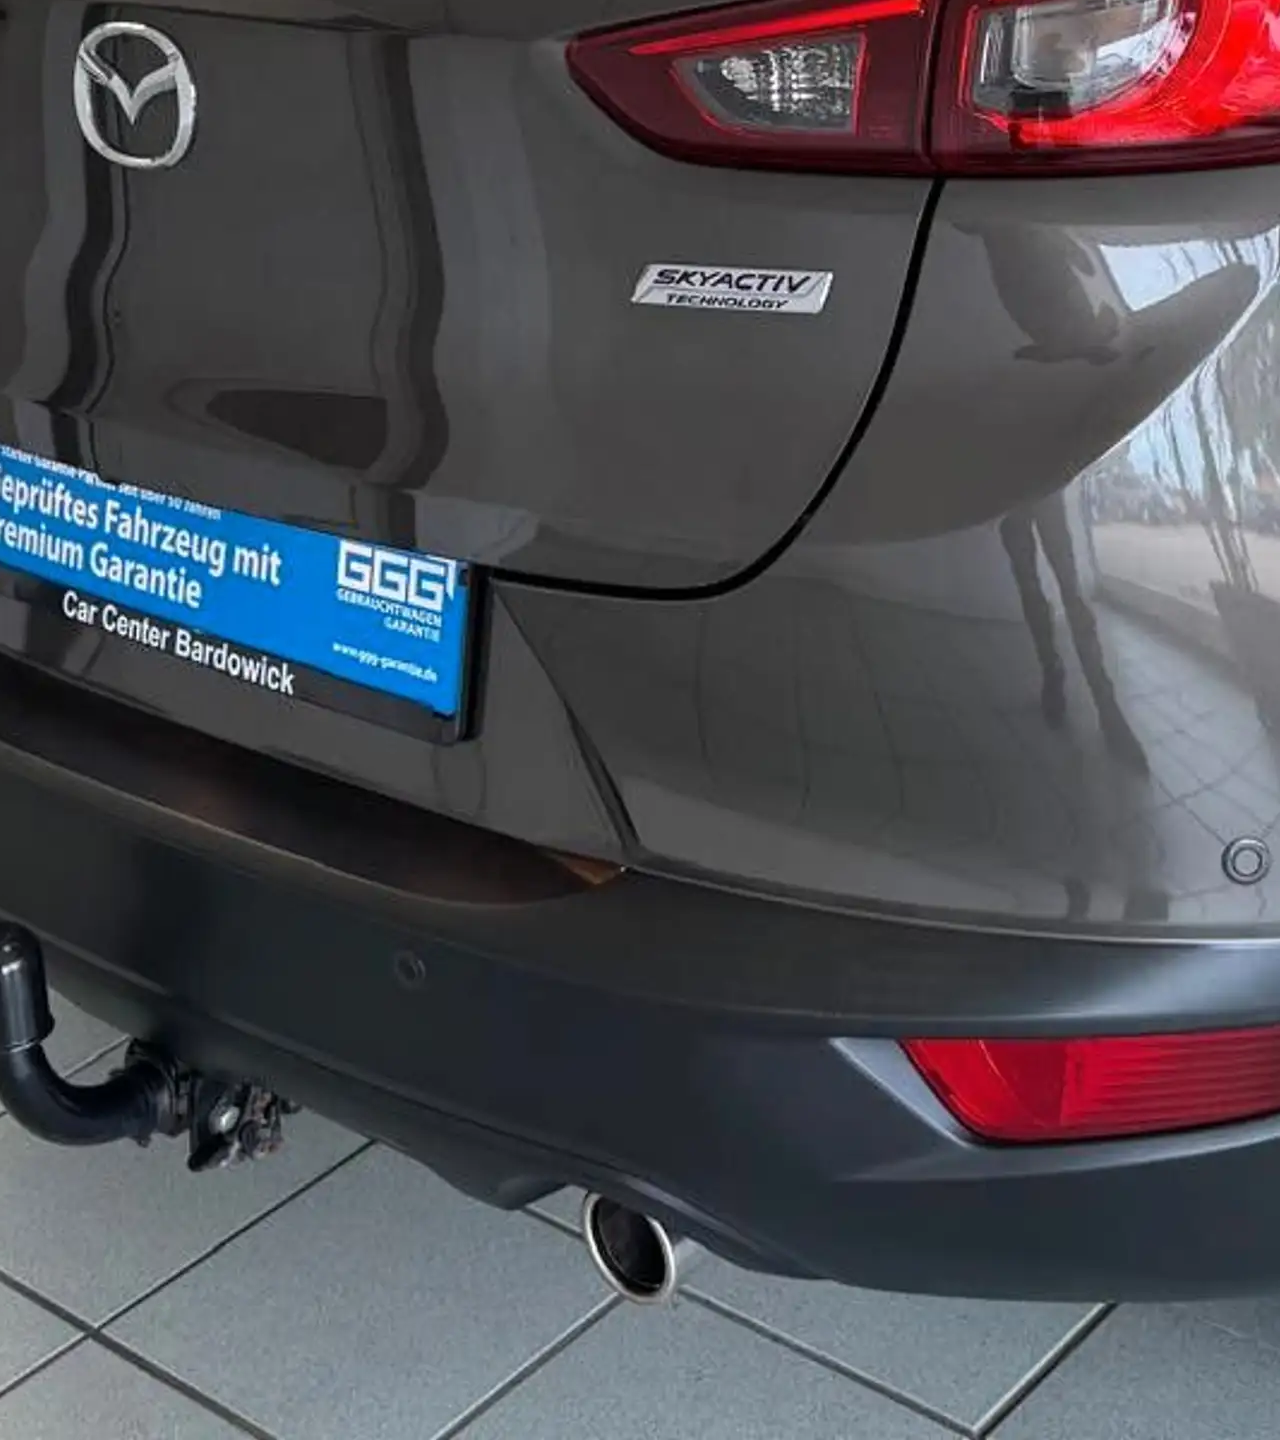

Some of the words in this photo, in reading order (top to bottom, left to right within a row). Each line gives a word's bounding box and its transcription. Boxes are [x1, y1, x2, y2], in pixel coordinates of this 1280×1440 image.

[653, 268, 811, 294] SKYACTIV
[666, 293, 789, 309] TECHNOLOGY
[104, 499, 227, 578] Fahrzeug
[232, 542, 282, 587] mit
[89, 540, 203, 609] Garantie
[337, 539, 447, 613] GGG
[336, 587, 442, 628] GEBRAUCHTWAGEN
[383, 616, 441, 643] GARANTIE
[62, 589, 98, 625] Car
[102, 603, 170, 651] Center
[174, 627, 296, 695] Bardowick
